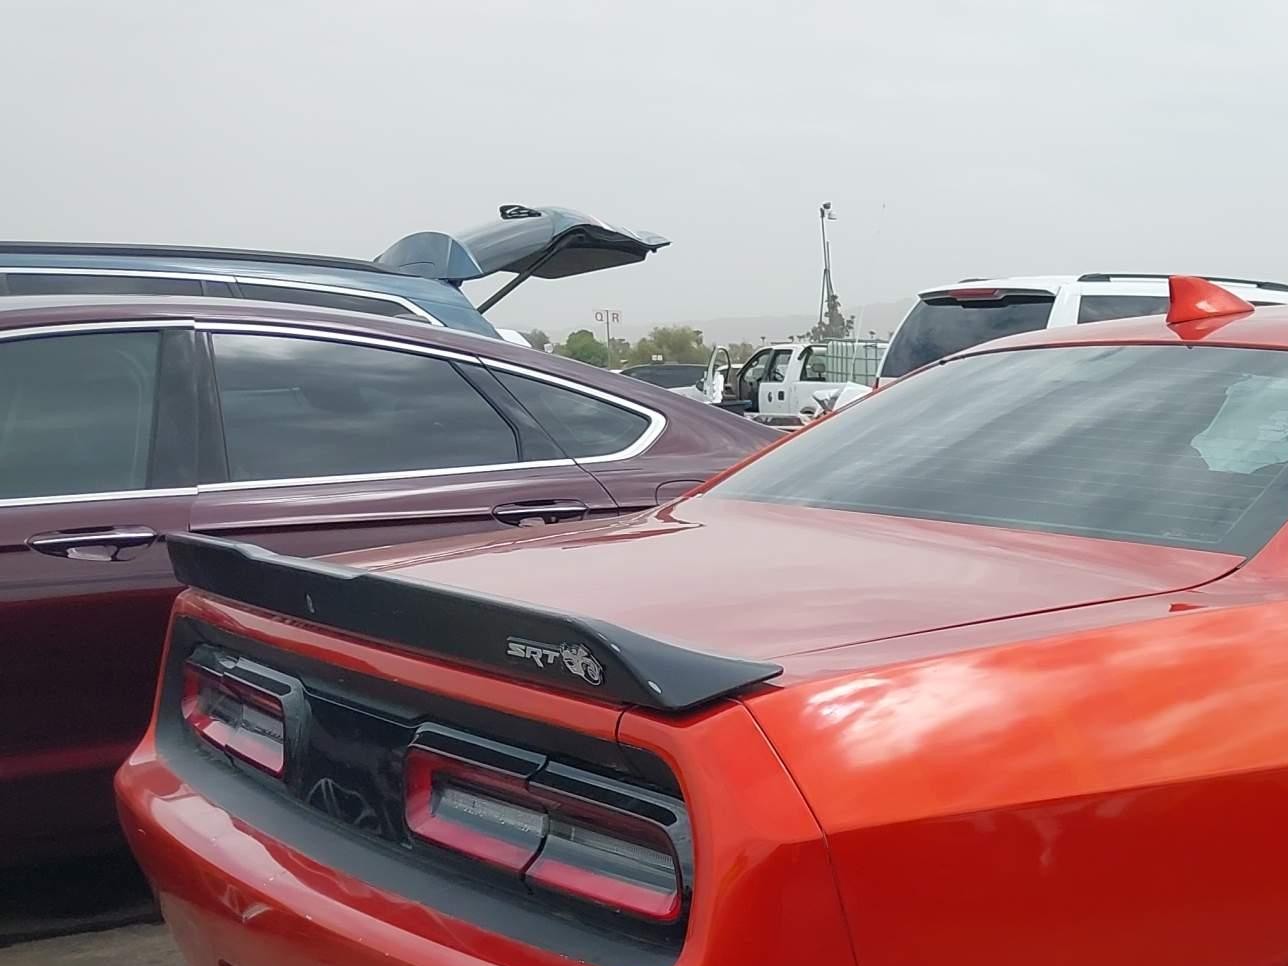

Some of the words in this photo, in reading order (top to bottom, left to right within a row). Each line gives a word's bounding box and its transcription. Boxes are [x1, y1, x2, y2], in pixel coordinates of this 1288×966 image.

[595, 311, 604, 322] Q
[612, 312, 620, 323] R
[507, 642, 560, 668] SRT
